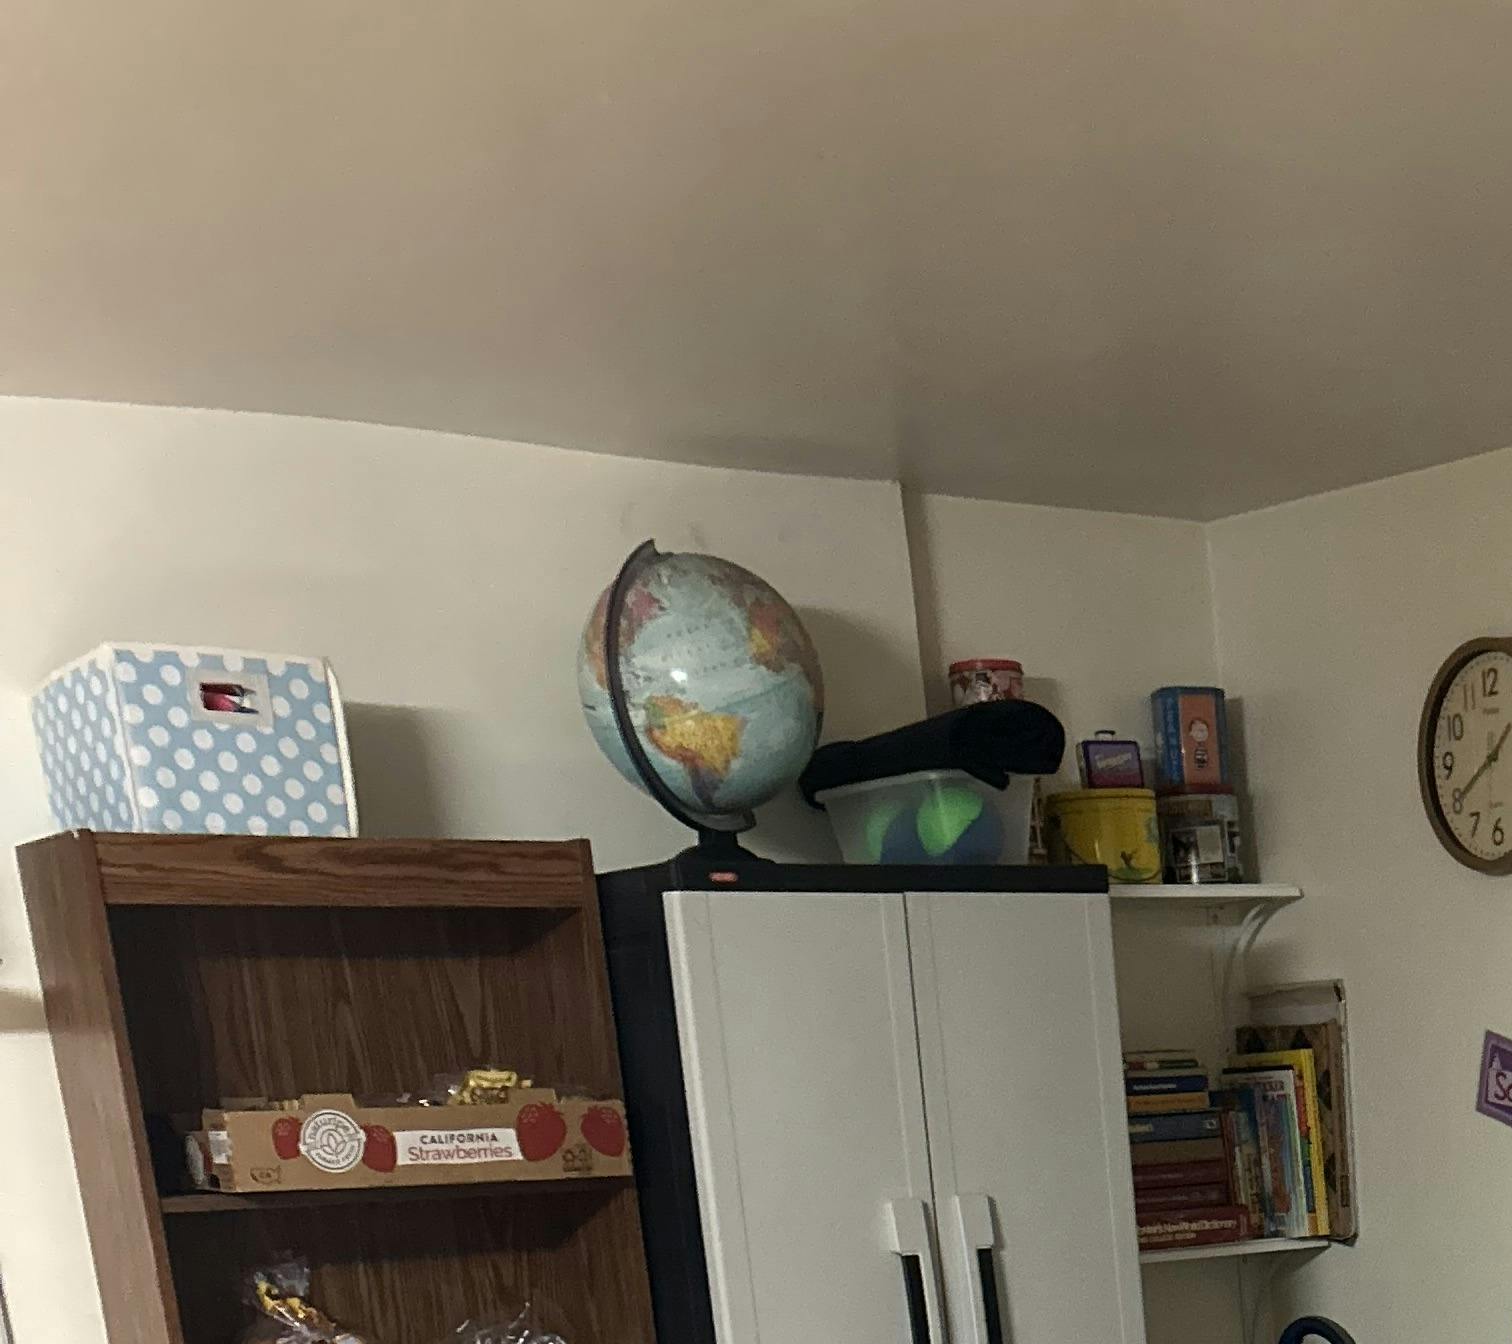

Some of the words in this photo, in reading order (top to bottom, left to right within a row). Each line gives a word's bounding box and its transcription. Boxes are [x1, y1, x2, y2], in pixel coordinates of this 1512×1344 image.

[1481, 667, 1499, 697] 12
[1463, 681, 1476, 712] 11
[1447, 713, 1464, 741] 10
[1442, 751, 1454, 780] 9
[1452, 788, 1465, 815] 8
[1469, 811, 1481, 838] 7
[1492, 818, 1504, 846] 6
[420, 1132, 498, 1145] CALIFORNIA
[408, 1145, 513, 1163] Strawberries
